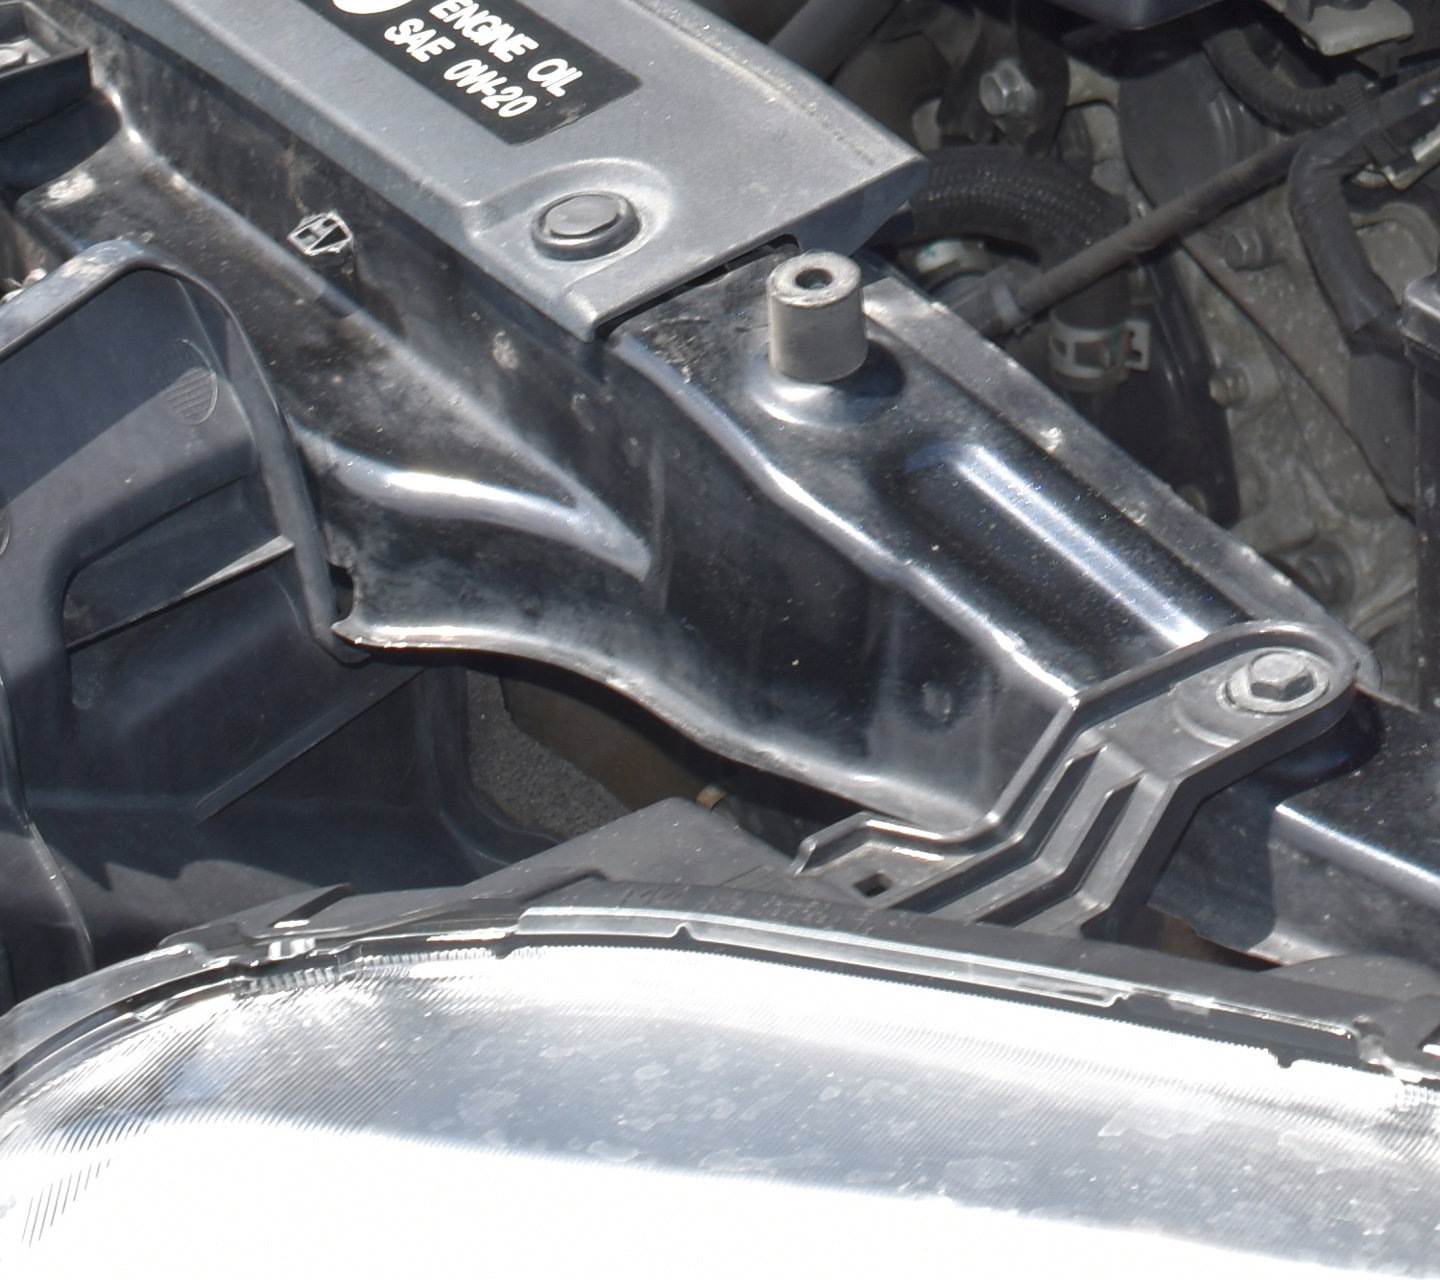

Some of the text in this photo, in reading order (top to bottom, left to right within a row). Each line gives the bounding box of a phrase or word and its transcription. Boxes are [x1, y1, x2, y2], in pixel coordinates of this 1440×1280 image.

[384, 18, 538, 118] SAE 0W-20
[527, 58, 583, 97] OIL
